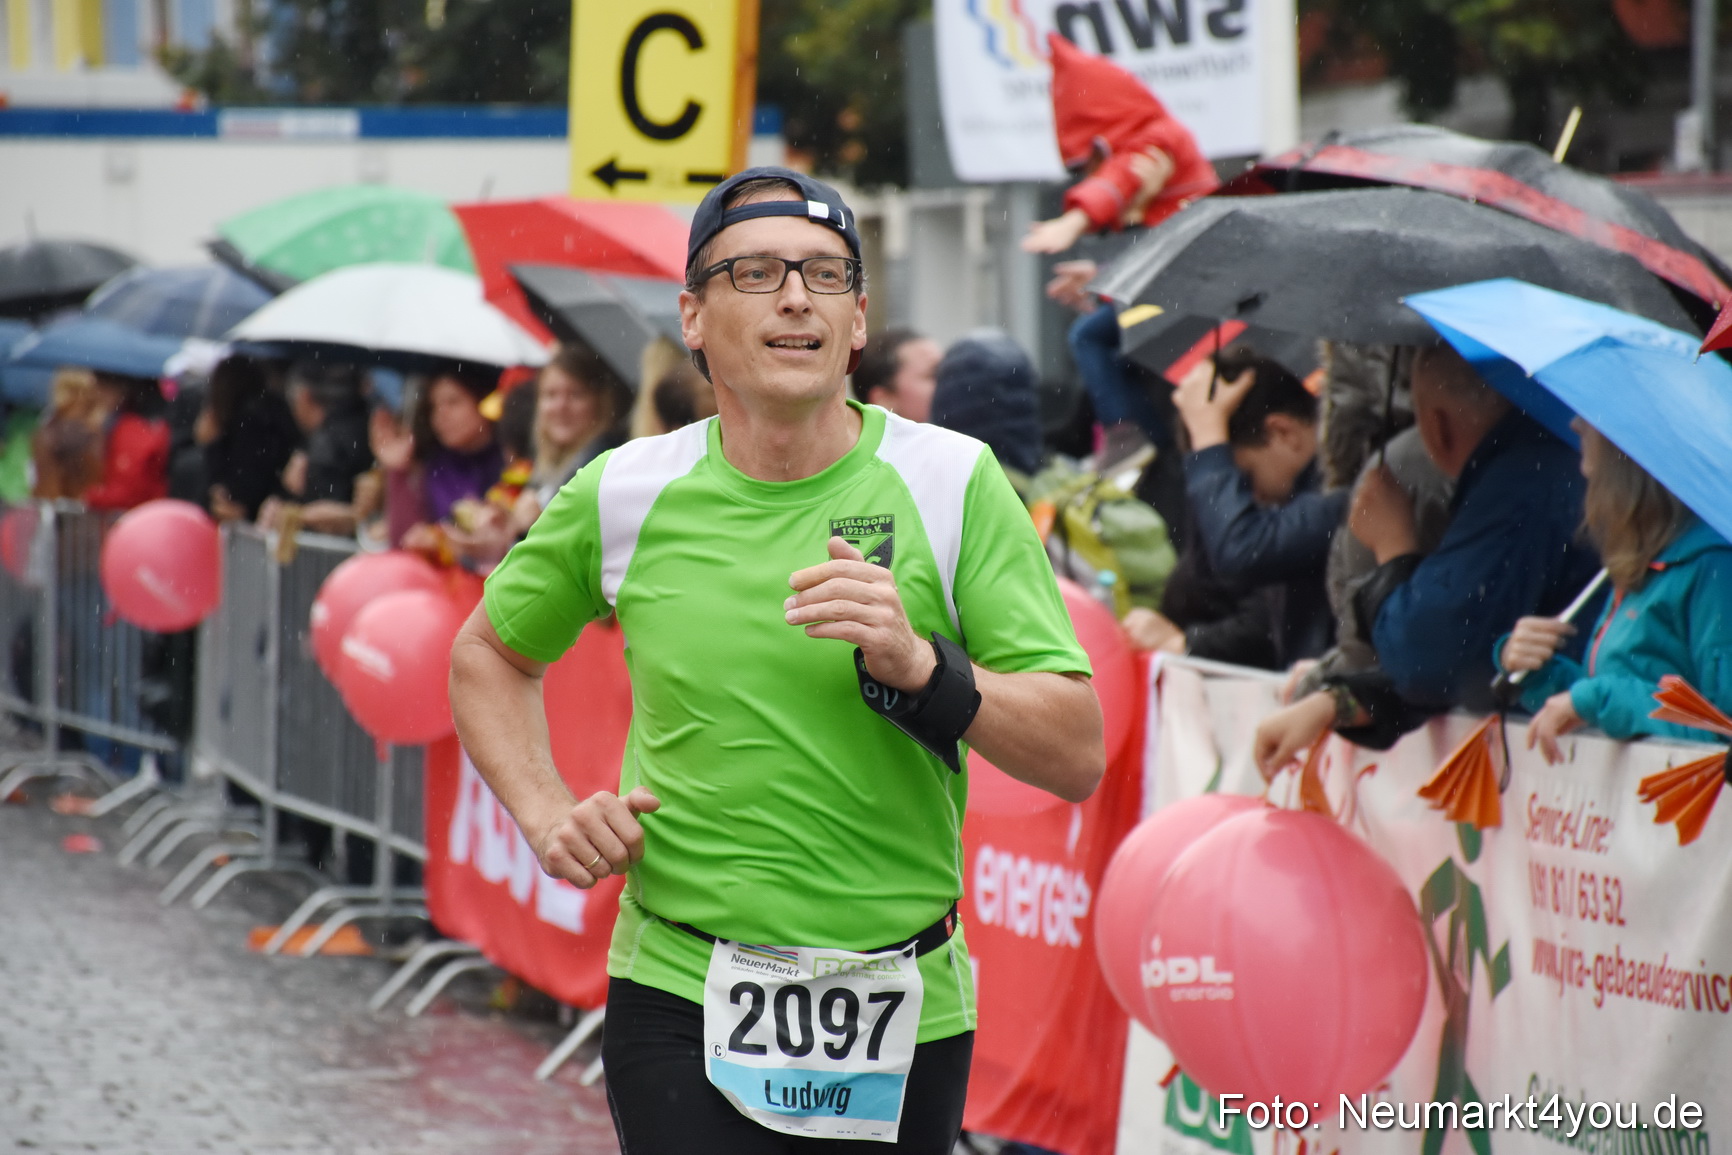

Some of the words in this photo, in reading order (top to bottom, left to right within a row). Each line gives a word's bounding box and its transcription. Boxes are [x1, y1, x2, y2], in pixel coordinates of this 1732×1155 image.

[619, 12, 705, 140] C
[833, 516, 892, 529] EZELSDORF
[842, 527, 865, 535] 1923
[866, 524, 882, 535] e.V.
[1578, 871, 1600, 922] 63
[1603, 875, 1627, 927] 52
[730, 953, 800, 978] NeuerMarkt
[728, 981, 906, 1061] 2097
[714, 1044, 722, 1057] C
[764, 1079, 852, 1115] Ludwig
